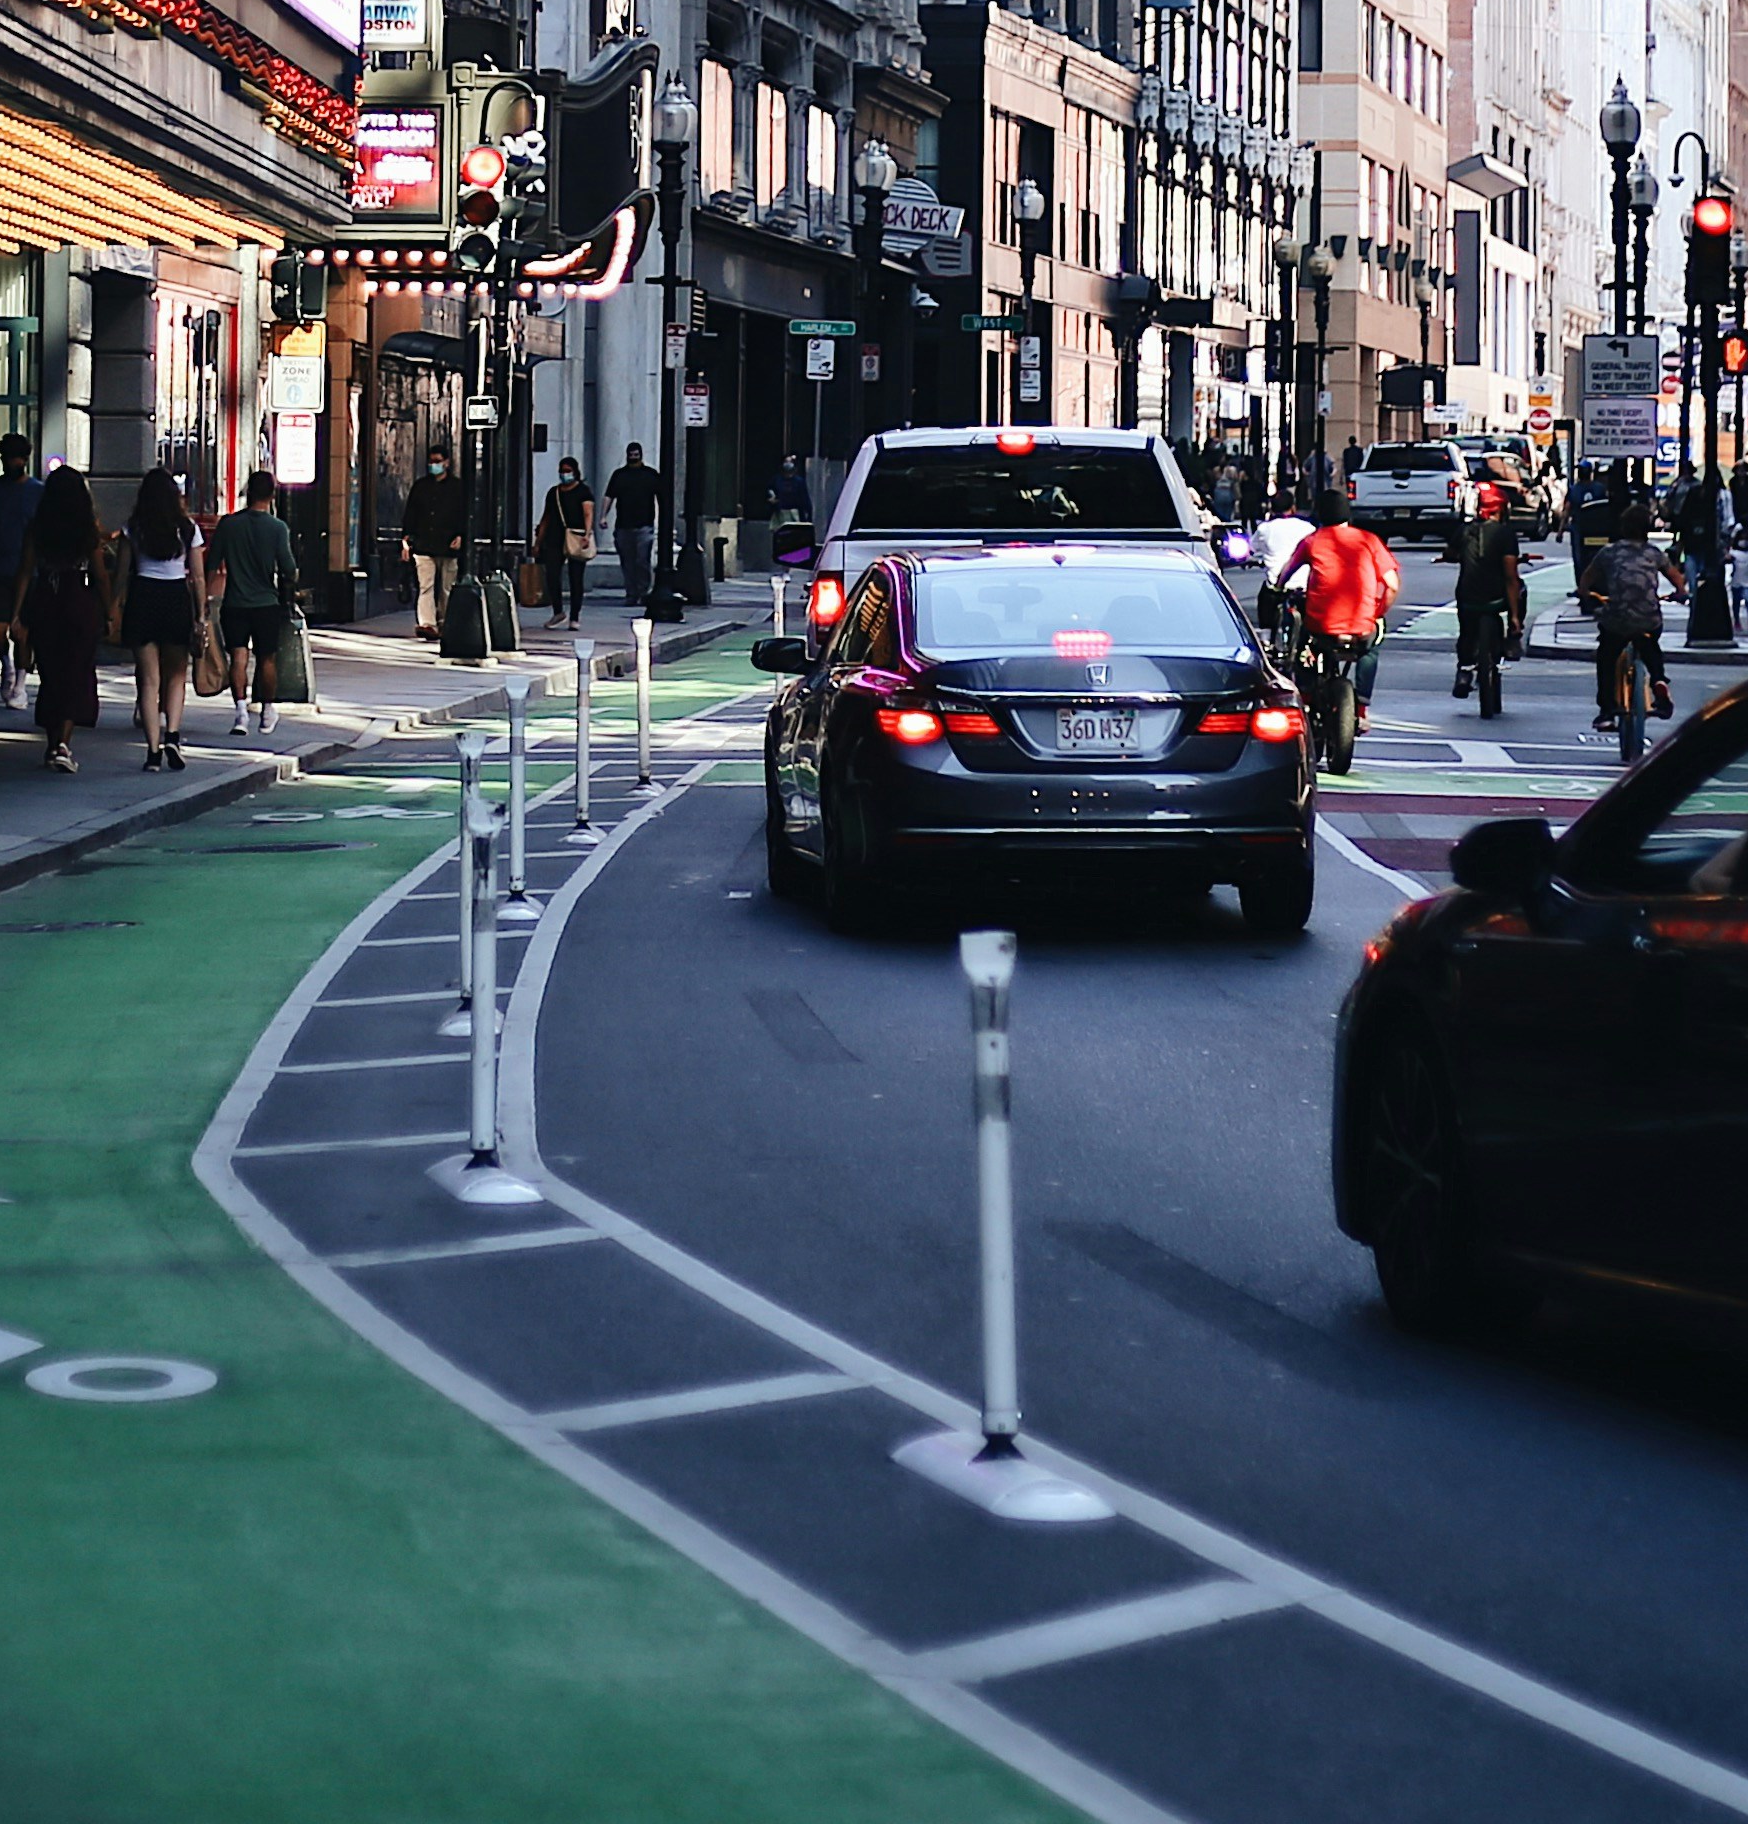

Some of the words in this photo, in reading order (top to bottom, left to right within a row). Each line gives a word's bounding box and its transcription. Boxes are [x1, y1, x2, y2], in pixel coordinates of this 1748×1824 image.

[363, 4, 419, 21] ADWAY
[364, 19, 416, 31] OSTON
[911, 206, 951, 231] DECK
[973, 318, 1002, 327] WEST
[282, 367, 312, 375] ZONE
[1061, 718, 1096, 740] 36D
